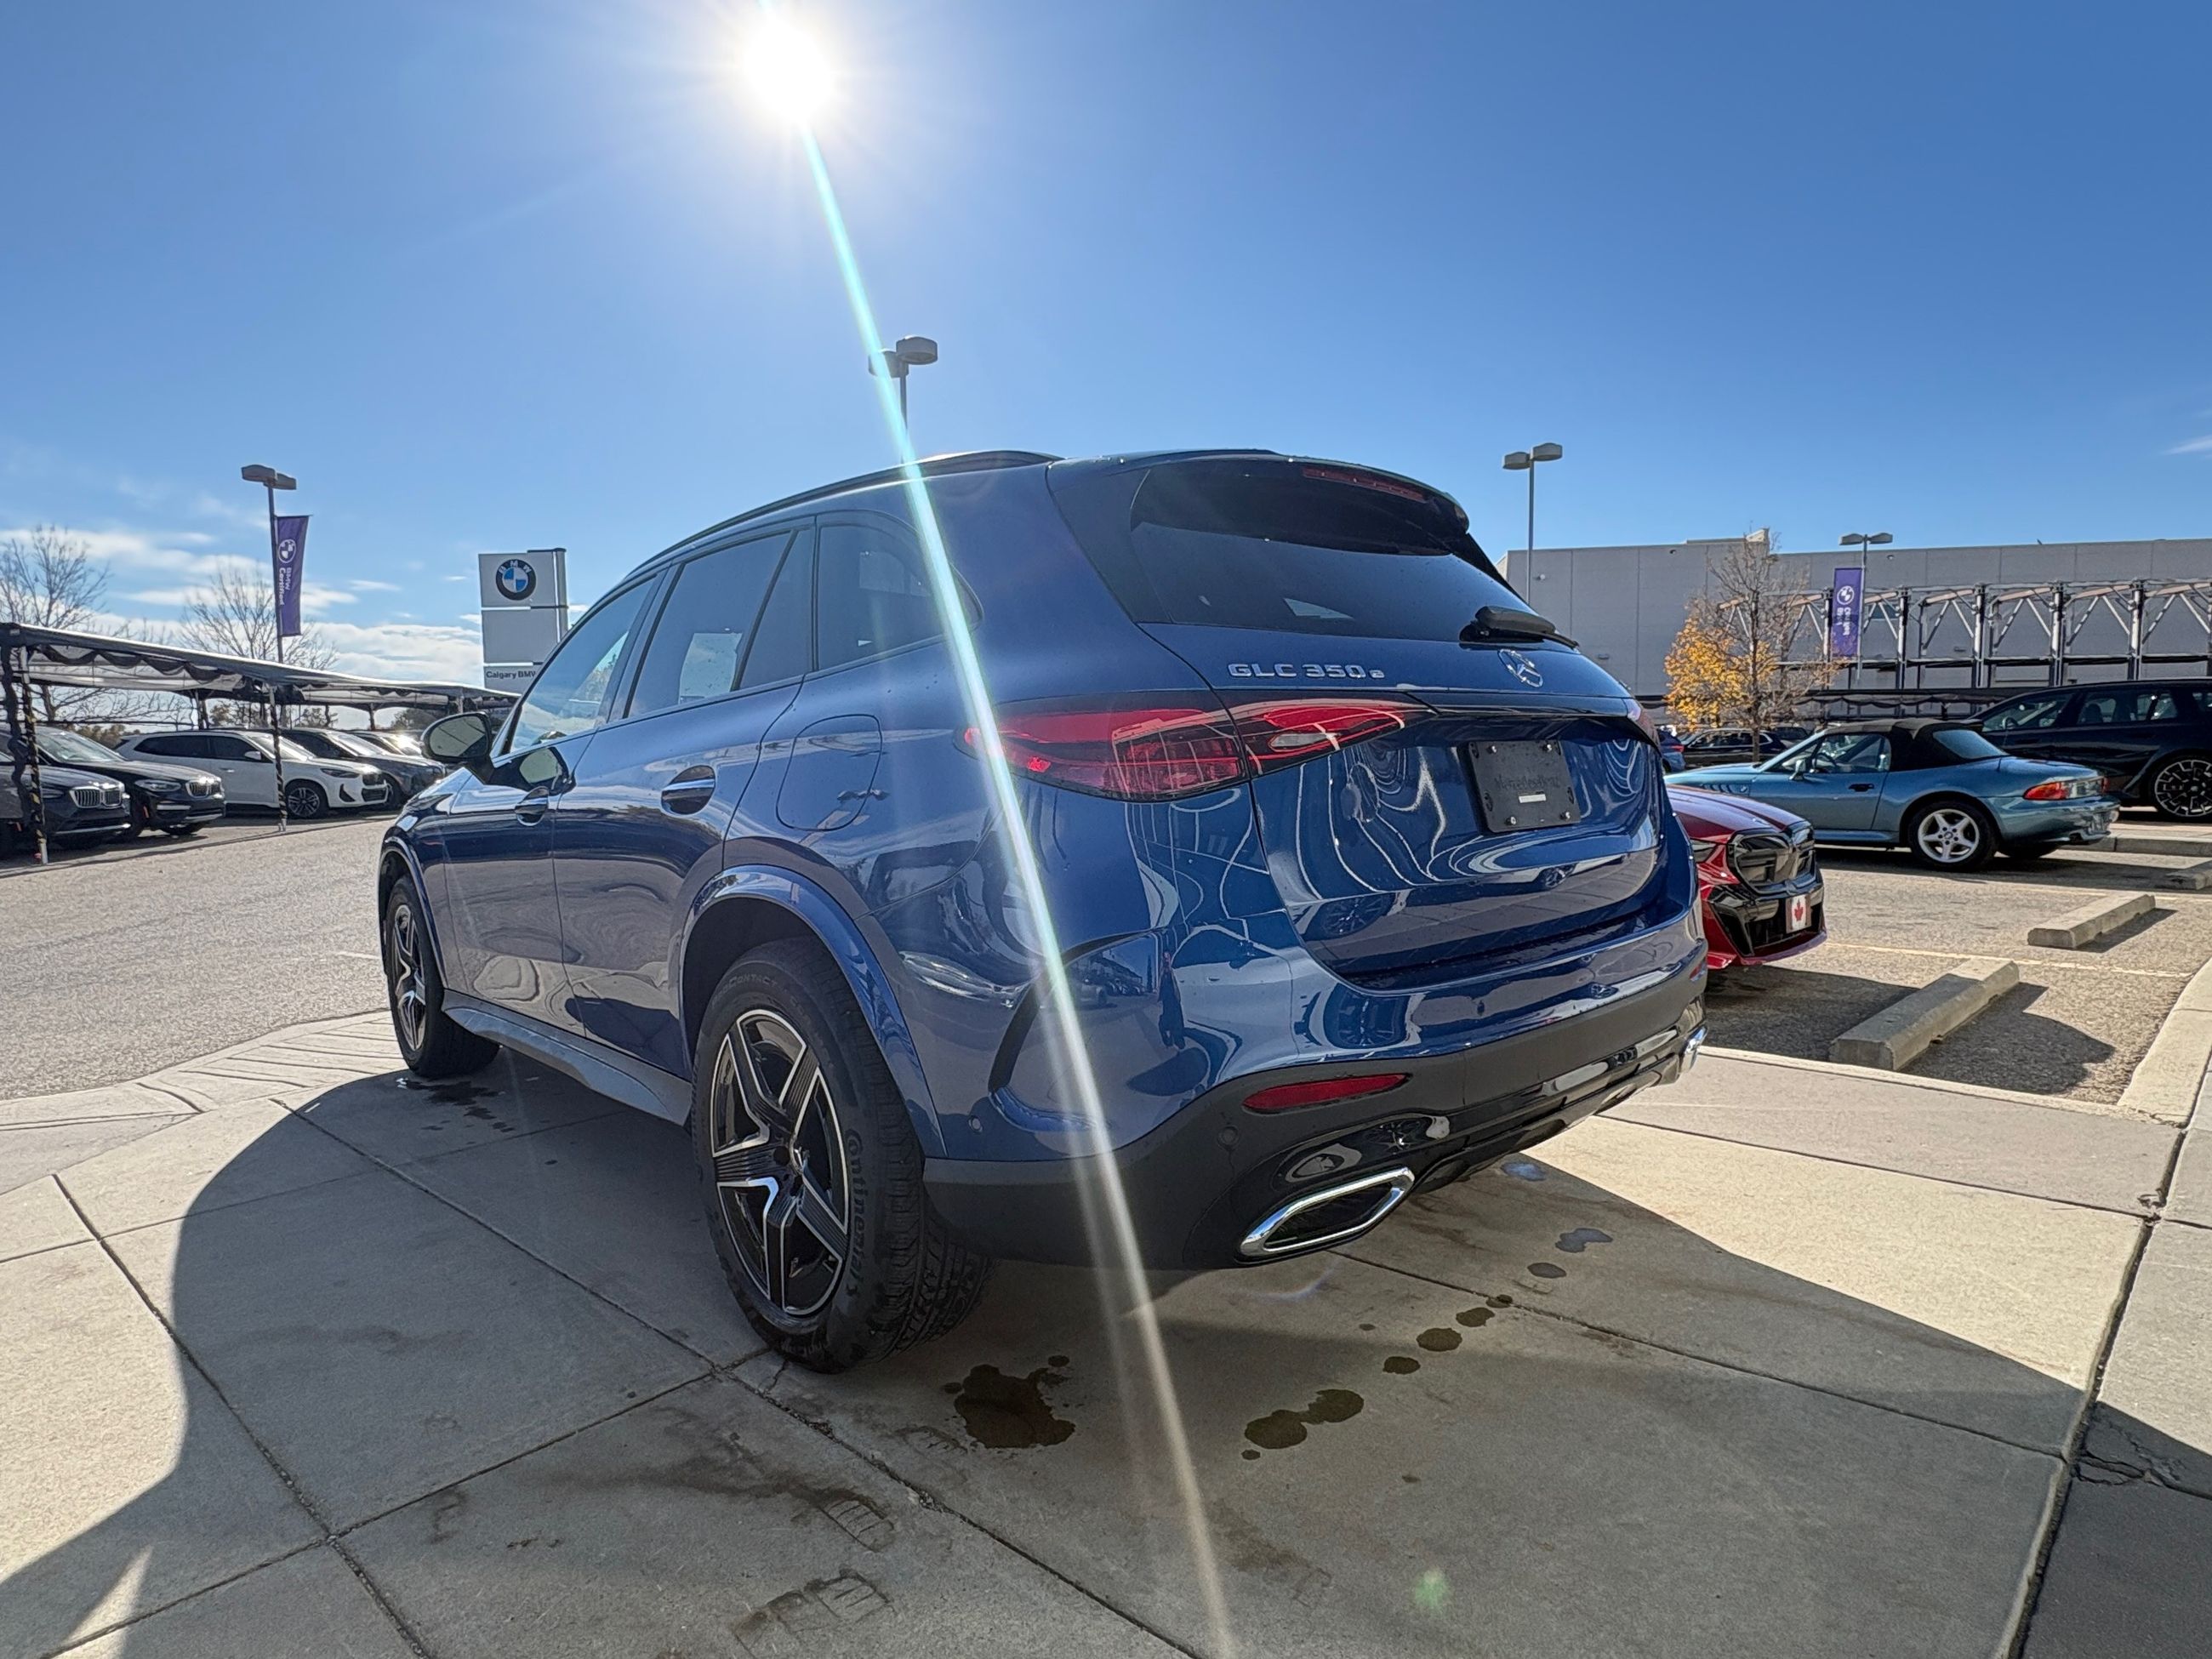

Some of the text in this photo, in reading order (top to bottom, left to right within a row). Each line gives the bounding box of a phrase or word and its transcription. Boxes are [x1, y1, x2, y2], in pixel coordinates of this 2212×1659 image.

[498, 560, 532, 574] BMW
[486, 670, 516, 680] Calgary
[1228, 664, 1297, 677] GLC
[845, 1128, 869, 1281] Continental
